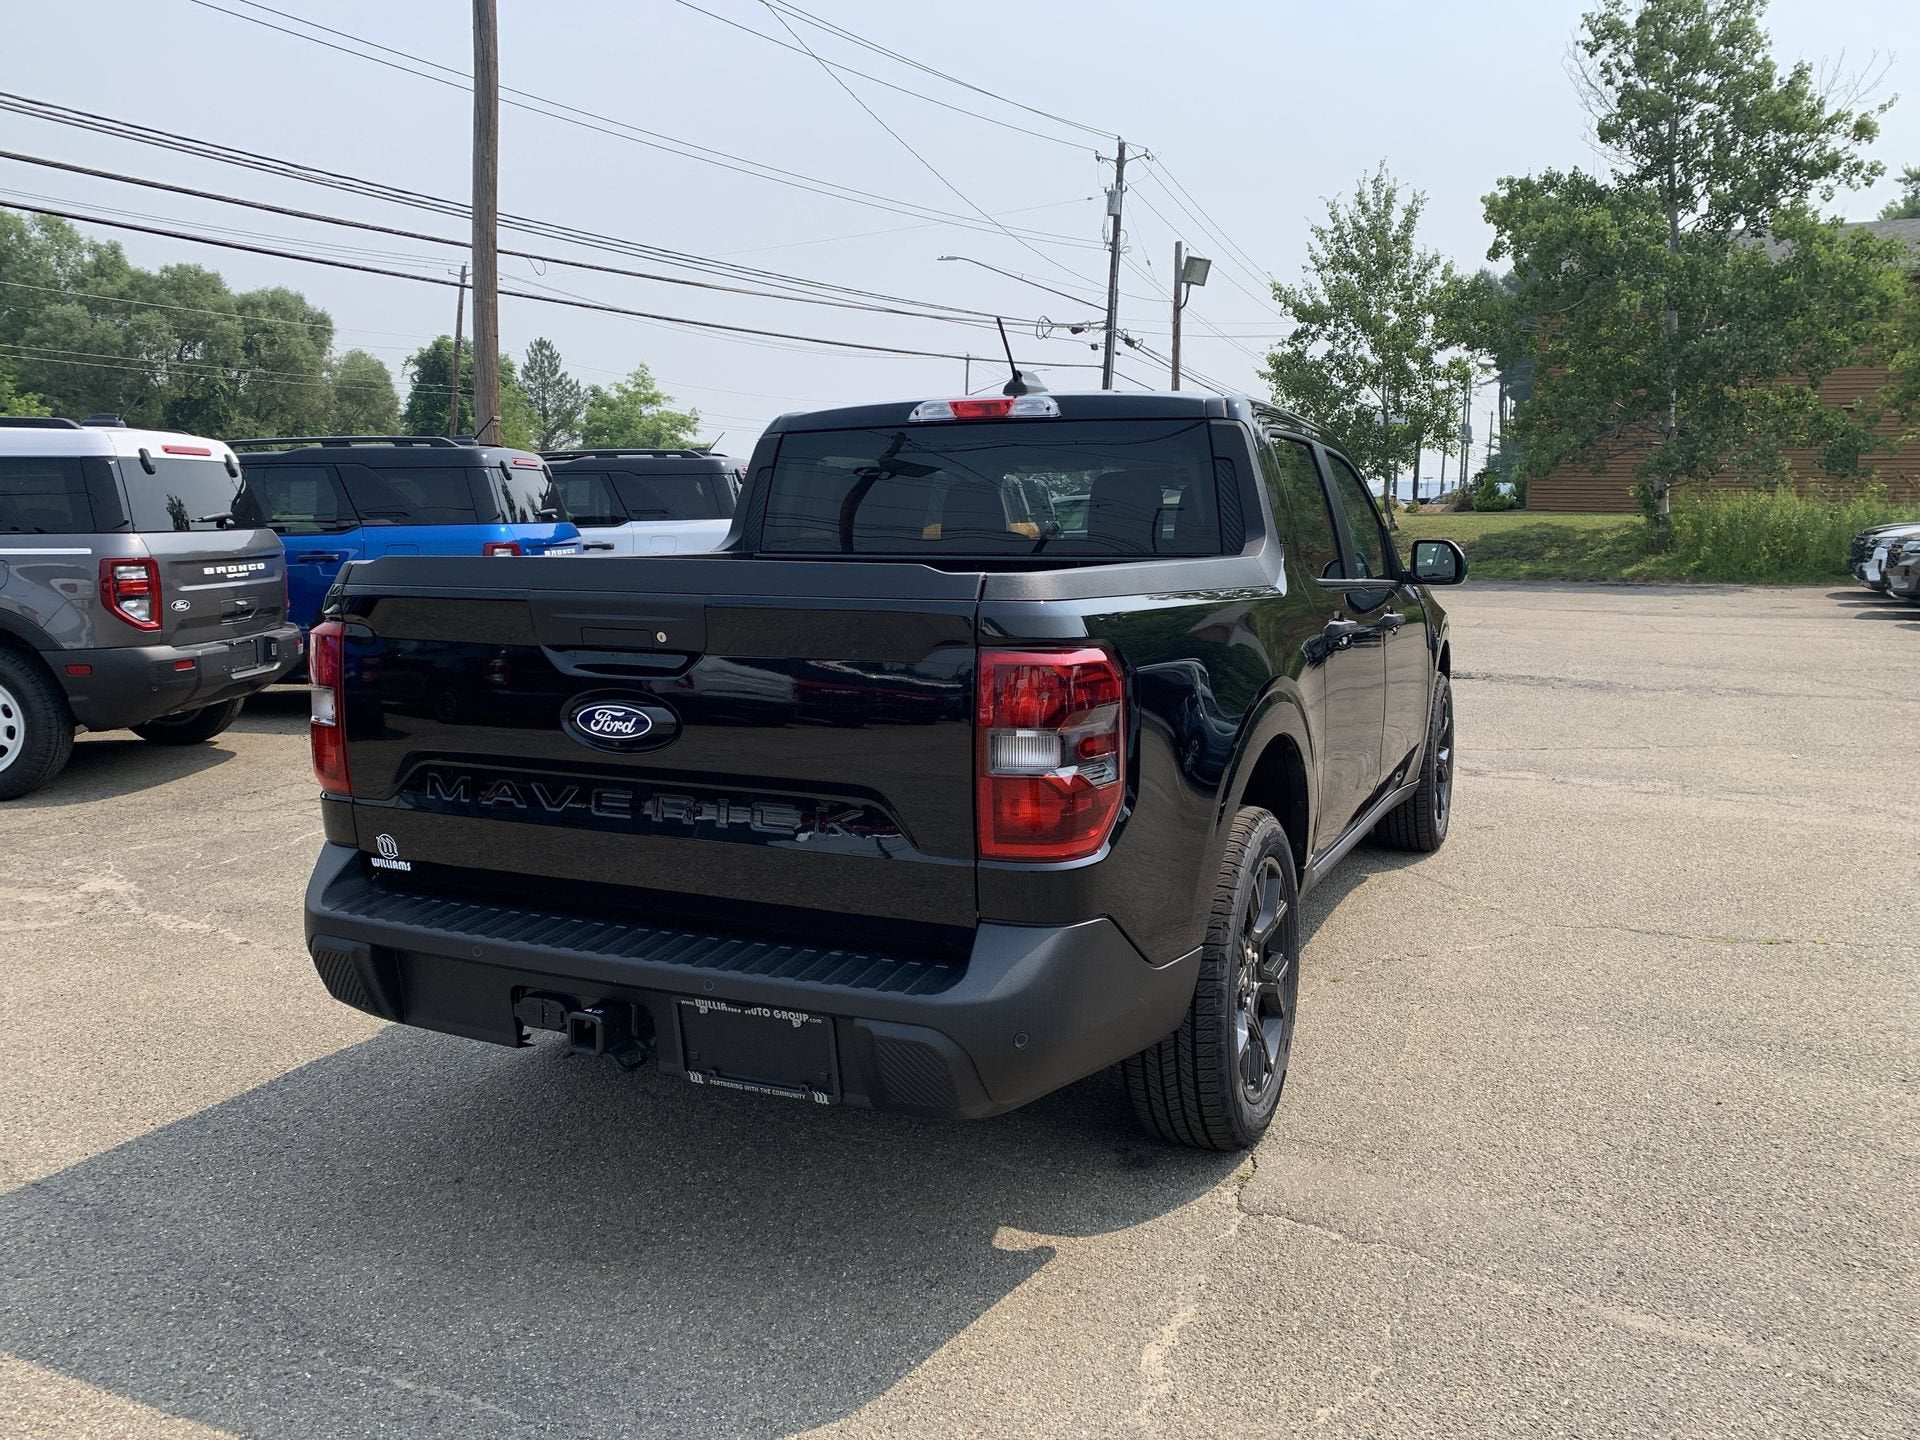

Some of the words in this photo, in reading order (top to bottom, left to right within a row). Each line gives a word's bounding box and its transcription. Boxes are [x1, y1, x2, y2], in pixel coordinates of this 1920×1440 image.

[203, 562, 265, 575] BRONCO
[590, 709, 637, 734] Ford
[426, 773, 865, 839] MAVERICK
[371, 857, 411, 871] WILLIAMS
[709, 1079, 743, 1090] PARTNERING
[744, 1084, 759, 1093] WITH
[760, 1087, 771, 1095] THE
[772, 1089, 806, 1100] COMMUNITY
